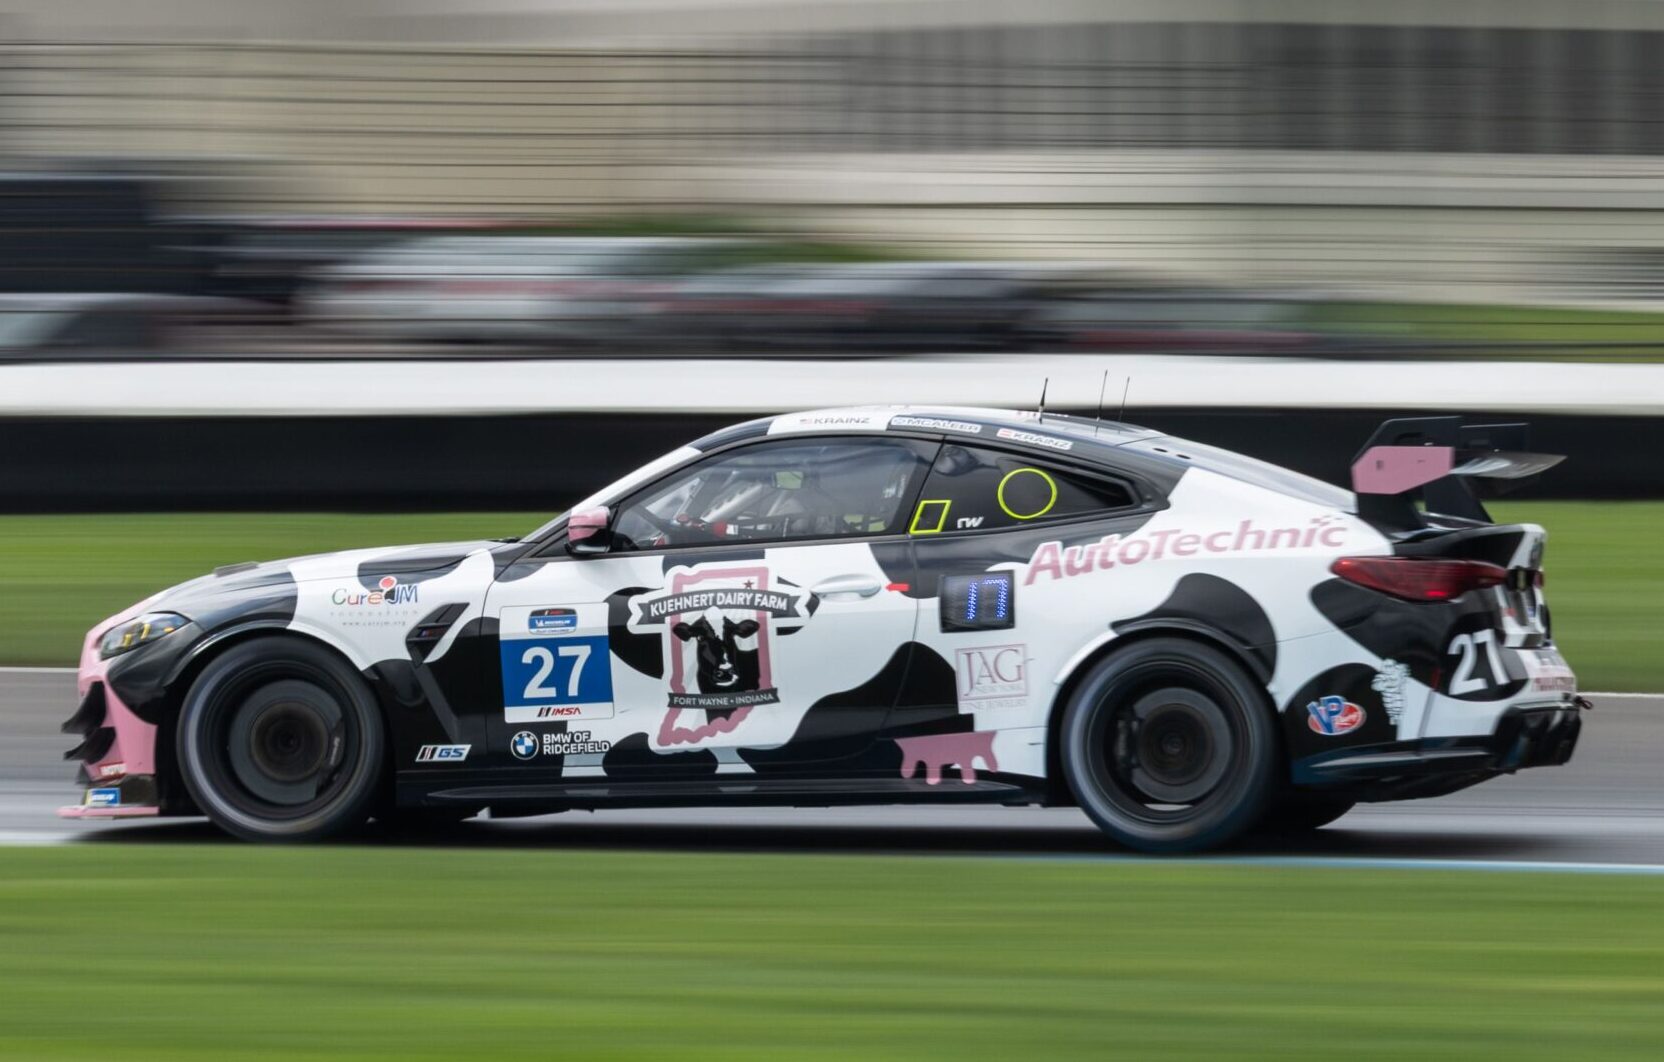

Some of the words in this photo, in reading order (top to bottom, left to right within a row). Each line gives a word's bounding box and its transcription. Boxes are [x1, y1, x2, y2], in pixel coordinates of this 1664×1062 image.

[814, 417, 870, 425] KRAINZ
[1024, 517, 1347, 586] AutoTechnic
[650, 593, 714, 617] KUEHNERT
[716, 592, 753, 606] DAIRY
[754, 593, 787, 611] FARM
[1448, 628, 1511, 696] 27
[522, 645, 591, 698] 27
[962, 648, 1023, 697] JAG
[673, 696, 697, 705] FORT
[698, 696, 729, 706] WAYNE
[735, 693, 774, 705] INDIANA
[551, 706, 582, 716] IMSA
[543, 733, 572, 744] BMW
[573, 732, 590, 742] OF
[438, 747, 466, 758] GS
[543, 742, 610, 755] RIDGEFIELD
